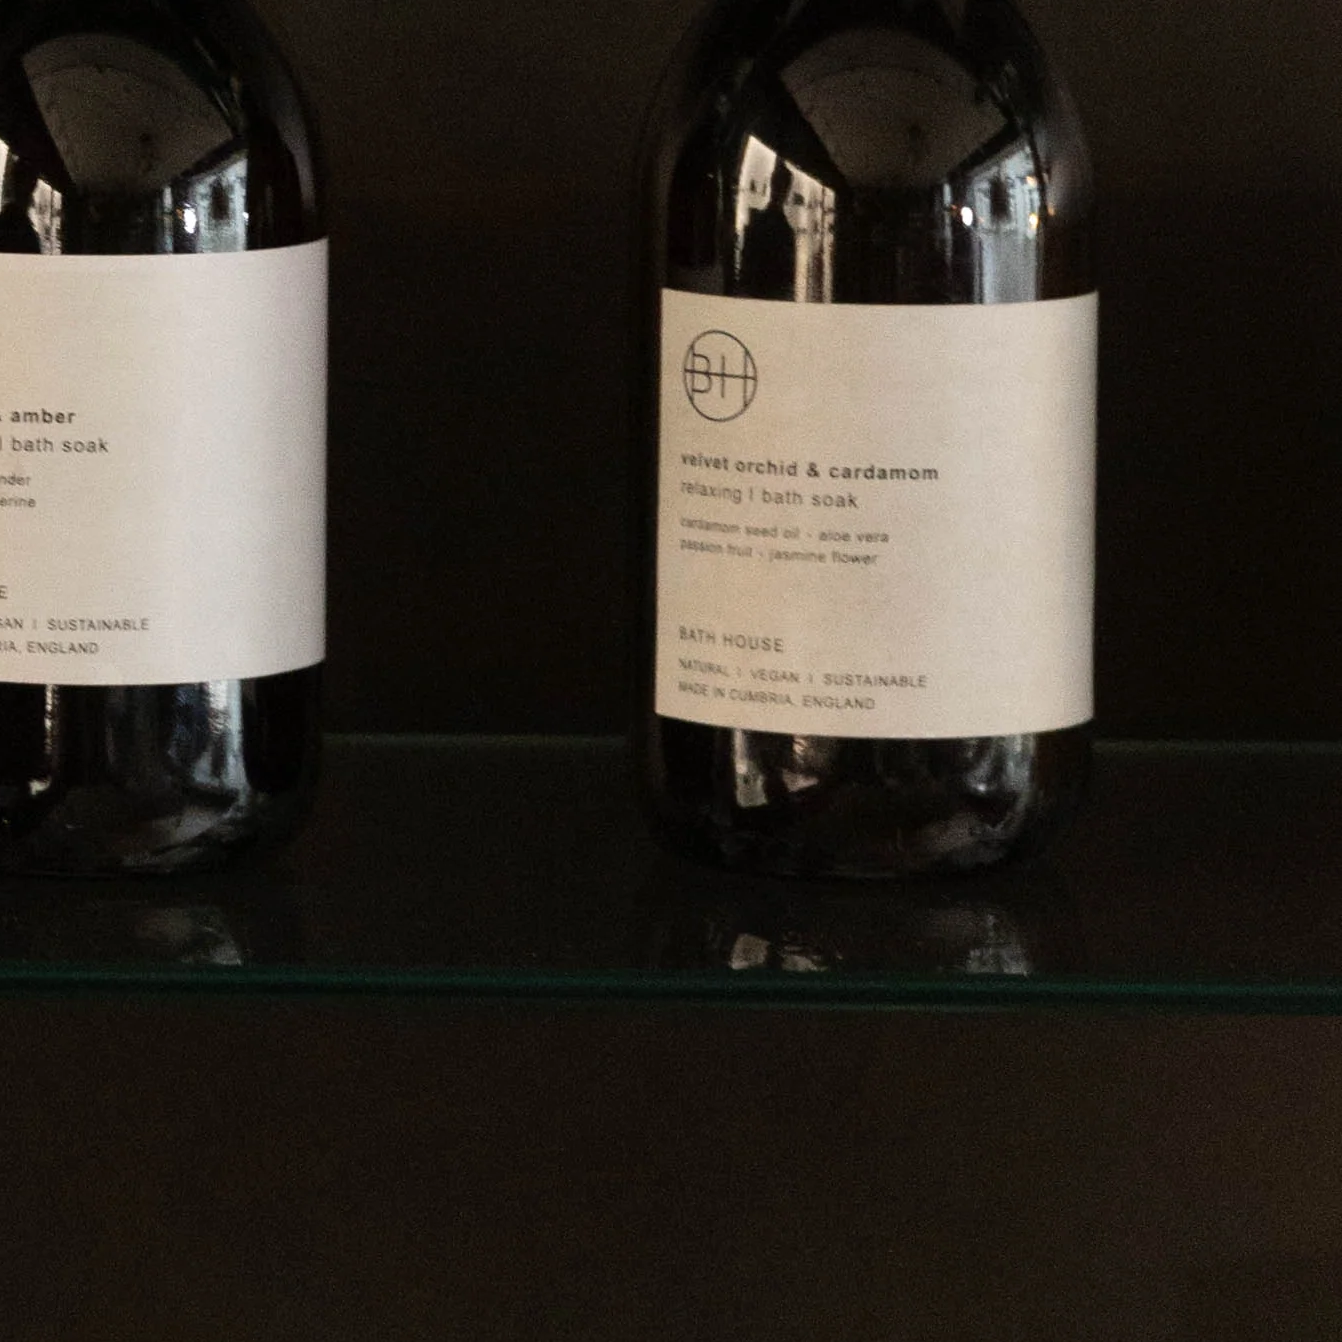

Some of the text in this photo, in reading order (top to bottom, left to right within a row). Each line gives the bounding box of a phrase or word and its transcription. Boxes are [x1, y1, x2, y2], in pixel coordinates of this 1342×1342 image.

[10, 407, 76, 424] amber
[11, 435, 54, 453] bath
[61, 437, 109, 454] soak
[680, 452, 939, 481] velvet orchid & cardamom
[680, 480, 859, 509] relaxing bath soak
[819, 530, 852, 542] aloe
[856, 533, 890, 543] vera
[769, 549, 826, 563] jasmine
[831, 550, 878, 564] flower
[47, 617, 150, 632] SUSTAINABLE
[27, 640, 99, 655] ENGLAND
[678, 626, 784, 653] BATH HOUSE
[750, 668, 800, 684] VEGAN
[823, 673, 928, 689] SUSTAINABLE
[802, 694, 876, 711] ENGLAND
